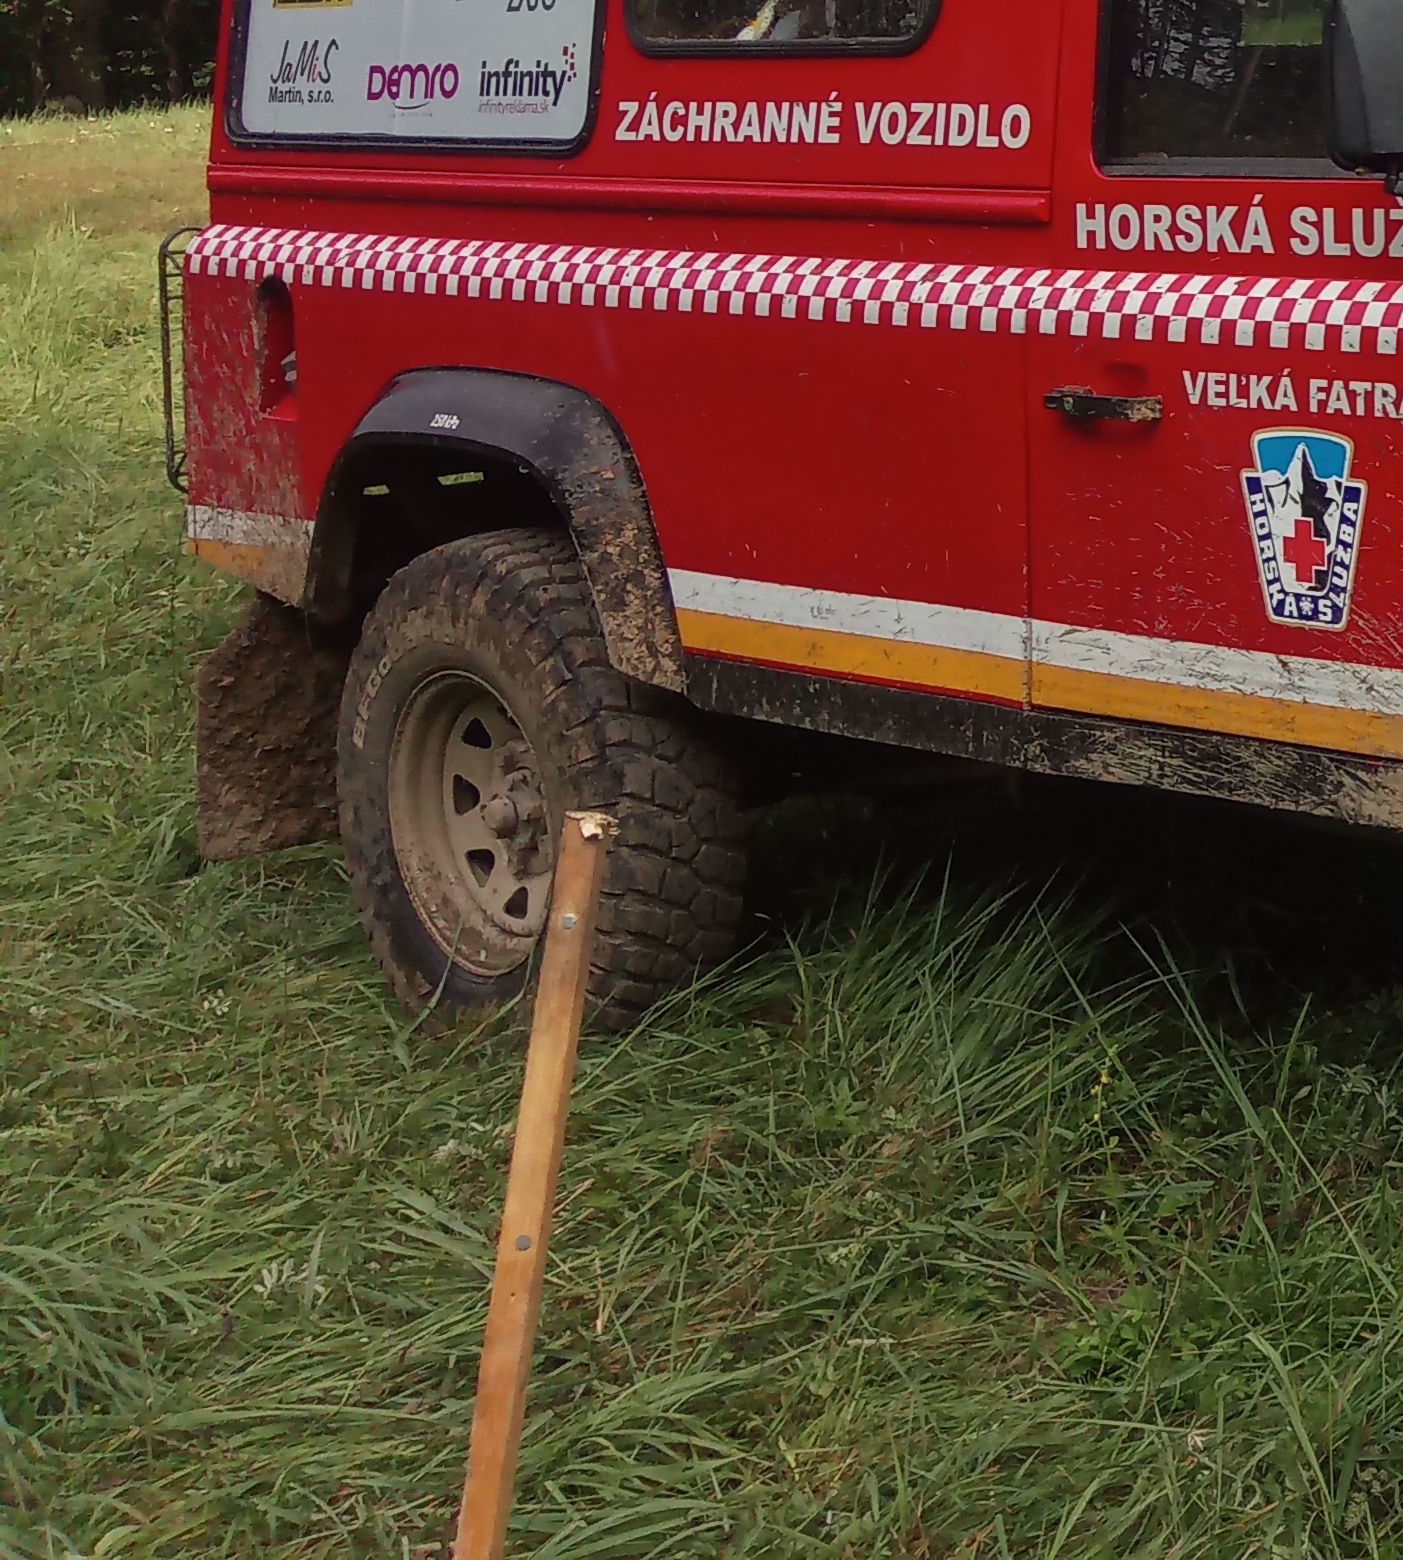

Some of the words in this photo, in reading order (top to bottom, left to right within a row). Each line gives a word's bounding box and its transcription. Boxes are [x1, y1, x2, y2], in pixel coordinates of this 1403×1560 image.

[268, 86, 304, 105] Martin,
[307, 89, 334, 104] s.r.o.
[479, 58, 567, 107] infinity
[615, 91, 842, 144] ZÁCHRANNÉ
[854, 101, 1031, 149] VOZIDLO
[1075, 194, 1275, 254] HORSKÁ
[1182, 367, 1298, 412] VEĽKÁ
